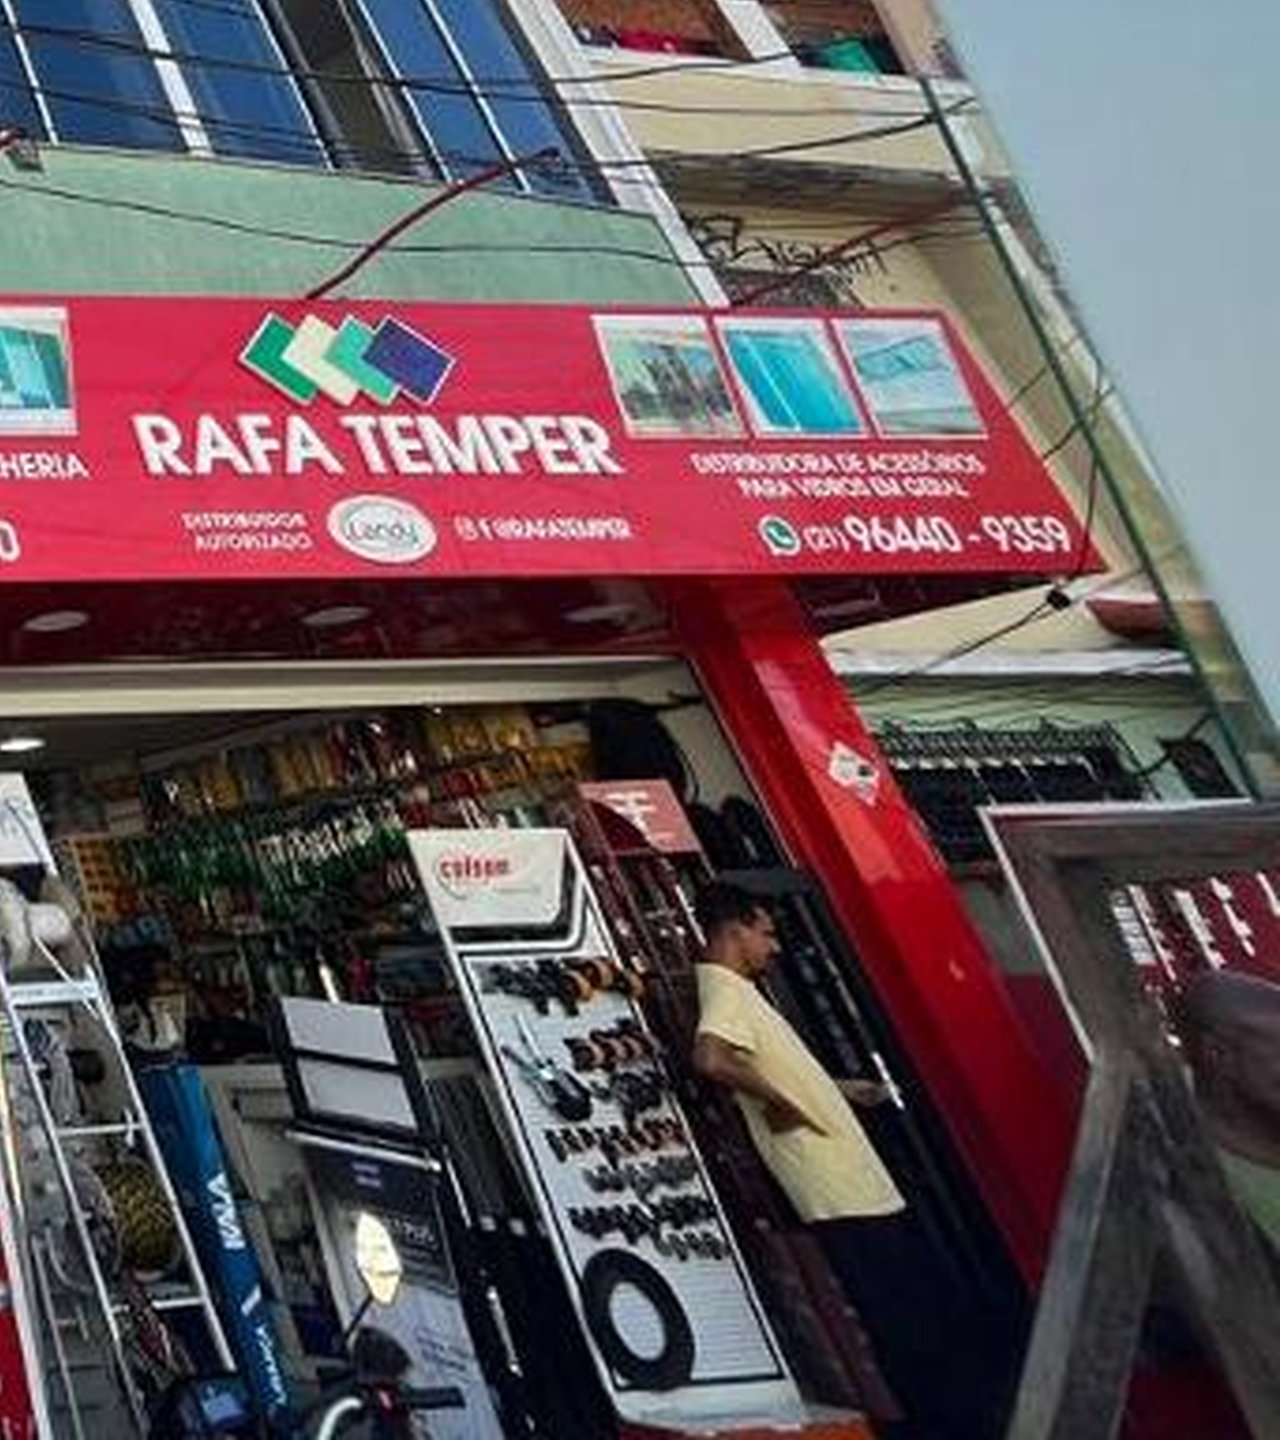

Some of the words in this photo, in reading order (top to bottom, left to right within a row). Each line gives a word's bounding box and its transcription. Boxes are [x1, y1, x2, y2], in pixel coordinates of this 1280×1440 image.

[134, 414, 344, 476] RAFA
[341, 414, 626, 476] TEMPER
[843, 515, 964, 553] 96440
[982, 515, 1072, 553] 9359
